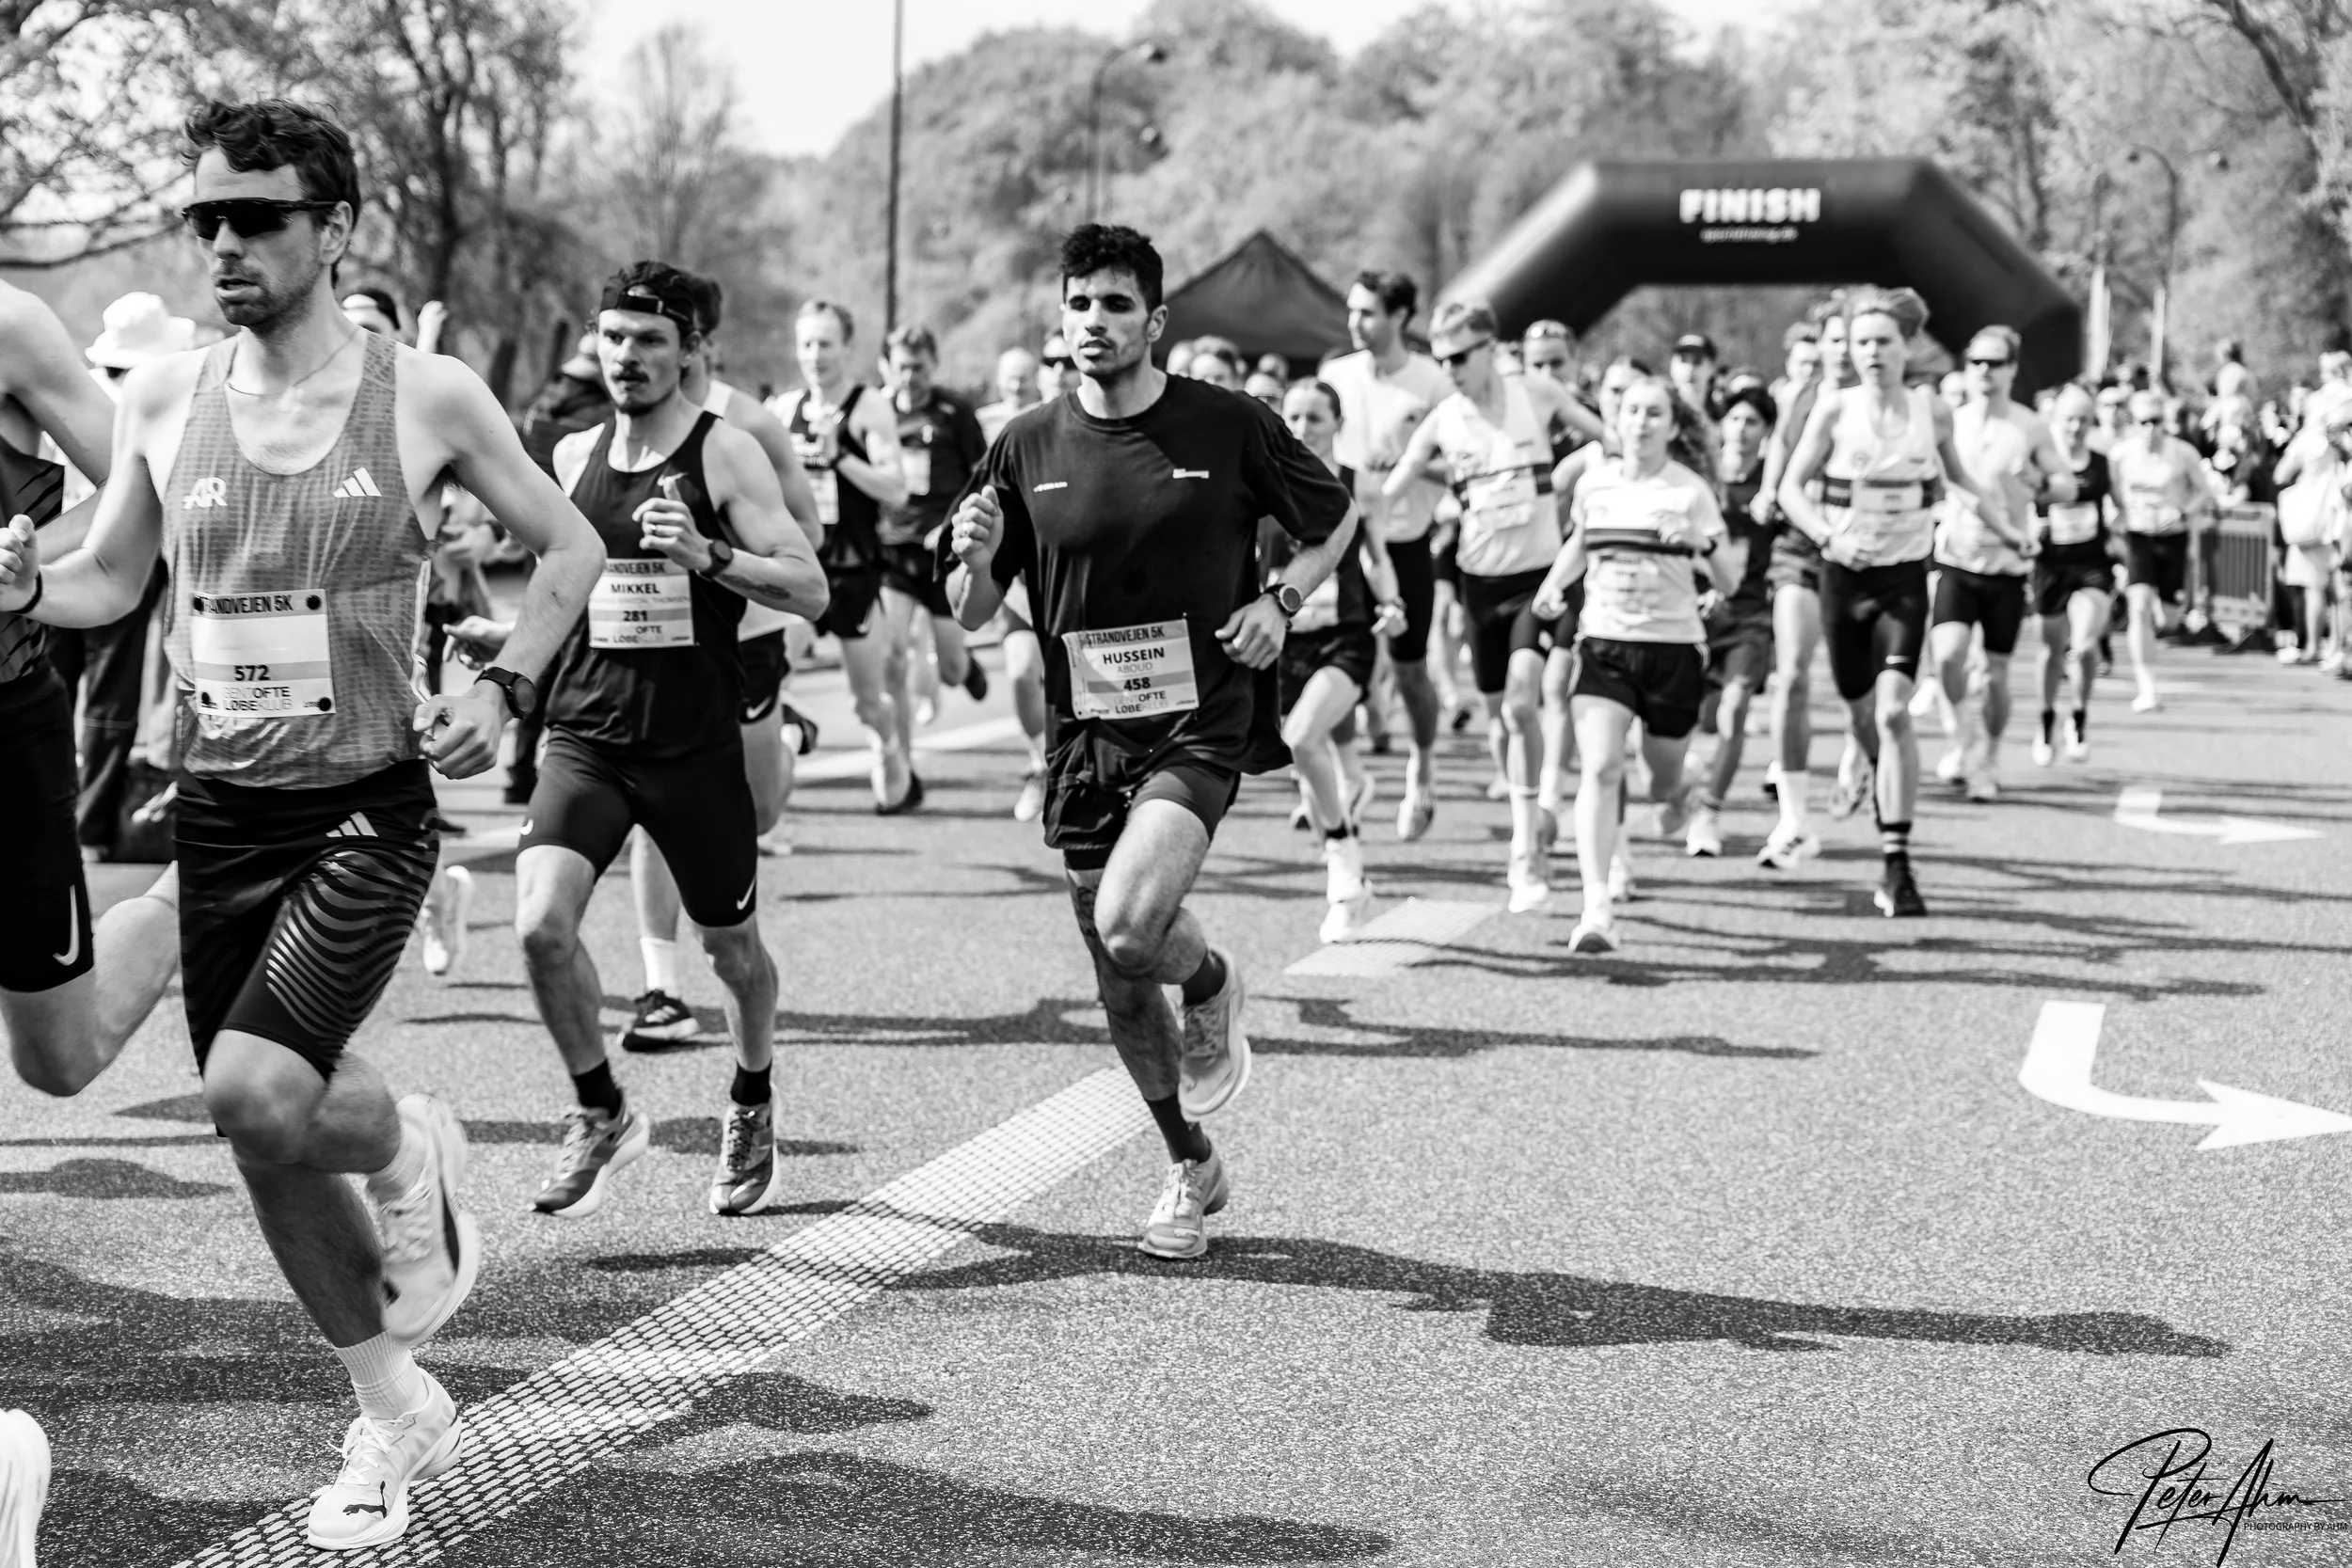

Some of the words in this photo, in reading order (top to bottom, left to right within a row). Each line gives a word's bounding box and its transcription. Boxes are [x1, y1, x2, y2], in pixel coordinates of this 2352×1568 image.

[1679, 188, 1821, 223] FINISH
[611, 582, 660, 594] MIKKEL
[193, 594, 272, 615] TRANDVEJEN
[273, 594, 294, 612] 5K
[622, 610, 648, 622] 281
[1086, 626, 1150, 646] STRANDVEJEN
[1151, 625, 1166, 639] 5K
[1103, 646, 1166, 665] HUSSEIN
[234, 664, 271, 682] 572
[1117, 661, 1154, 674] ABOUD
[1123, 676, 1152, 692] 458
